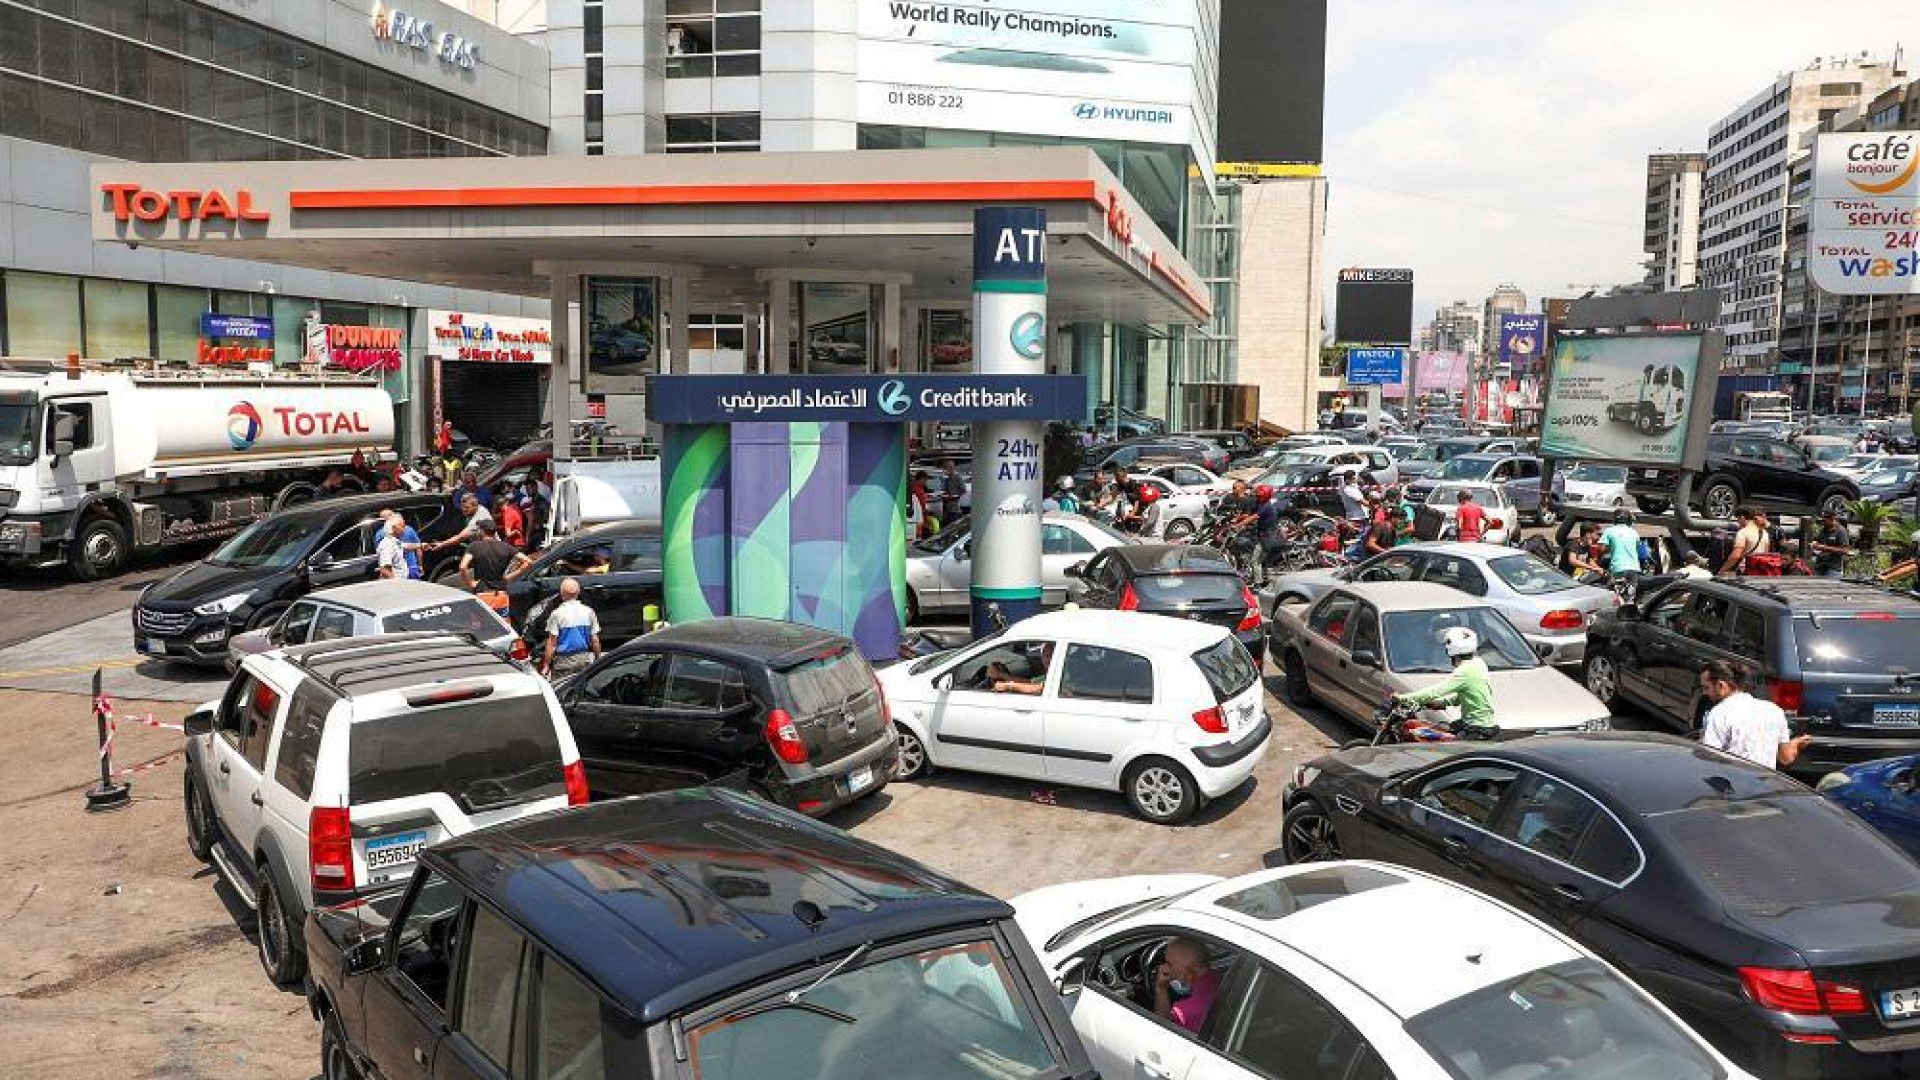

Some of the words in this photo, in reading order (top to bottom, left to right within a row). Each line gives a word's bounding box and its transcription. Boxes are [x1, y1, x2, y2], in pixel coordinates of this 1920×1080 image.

[890, 3, 948, 23] World
[953, 9, 1001, 31] Rally
[1004, 13, 1118, 39] Champions.
[888, 91, 903, 105] 01
[939, 95, 964, 108] 222
[1103, 106, 1173, 124] HYUNDAI
[1847, 135, 1913, 162] café
[1848, 163, 1898, 175] bonjour
[102, 183, 271, 221] TOTAL
[1833, 201, 1880, 210] TOTAL
[1818, 247, 1871, 256] TOTAL
[721, 388, 801, 414] المصرفي
[804, 388, 867, 408] الاعتماد
[920, 387, 1027, 408] Creditbank
[273, 406, 370, 436] TOTAL
[998, 438, 1040, 458] 24hr
